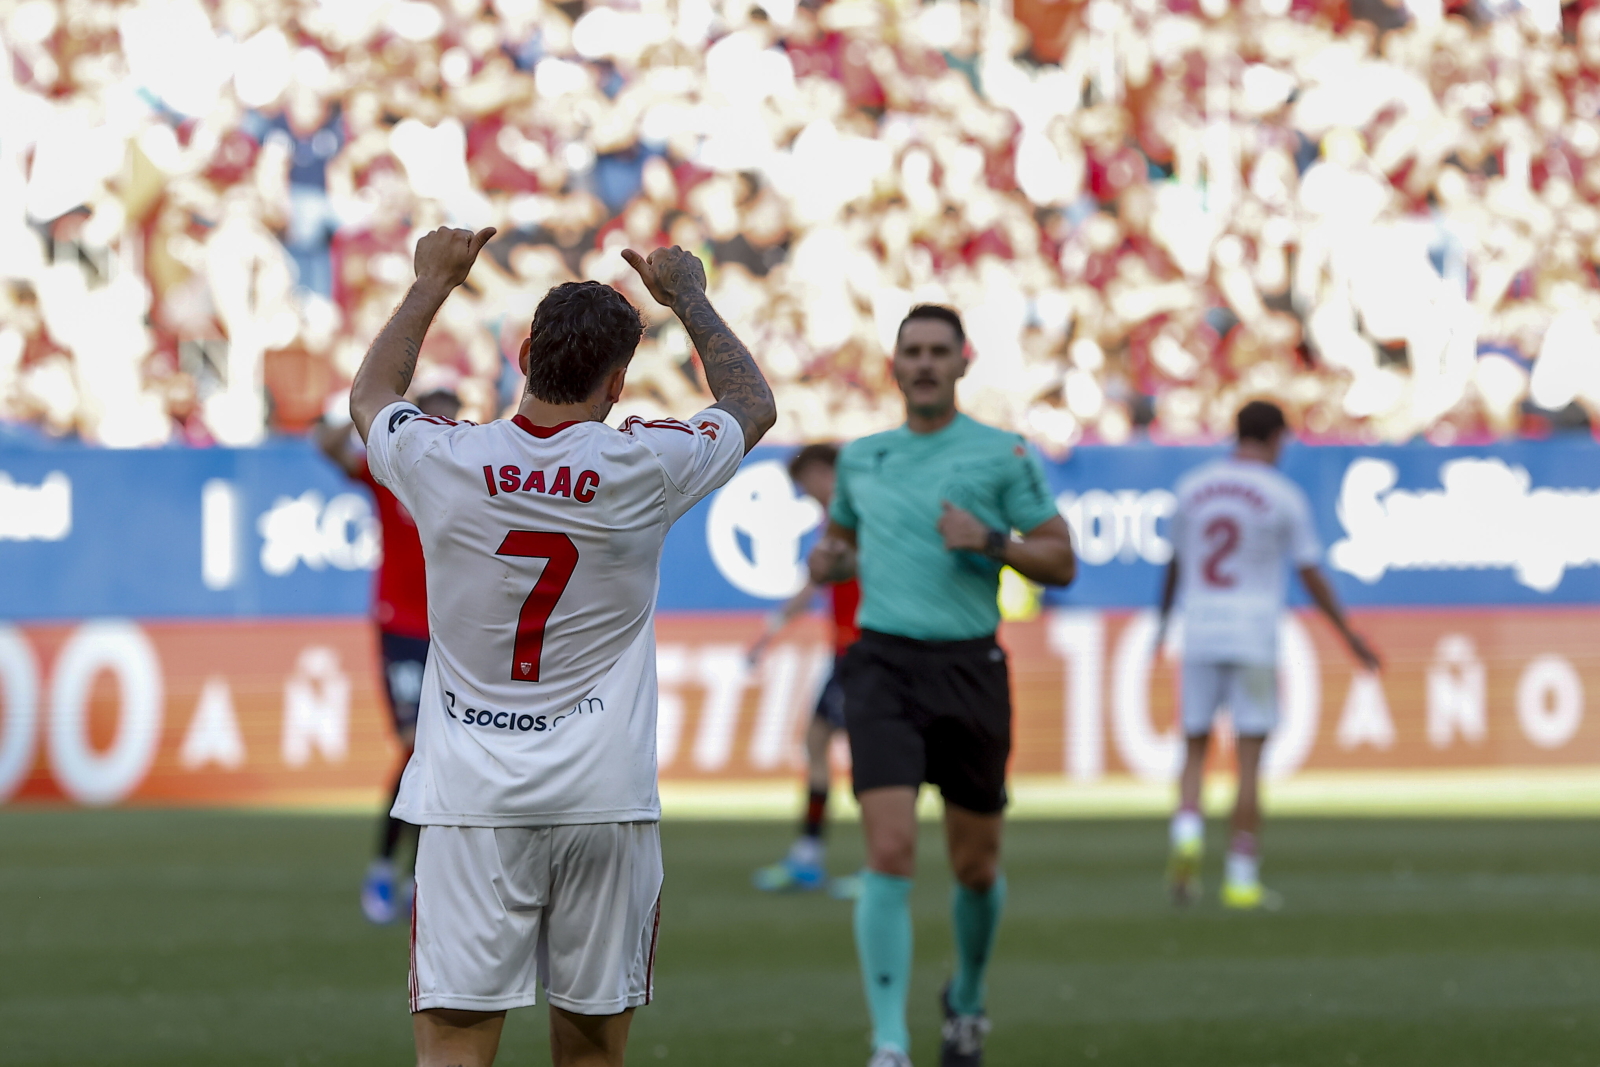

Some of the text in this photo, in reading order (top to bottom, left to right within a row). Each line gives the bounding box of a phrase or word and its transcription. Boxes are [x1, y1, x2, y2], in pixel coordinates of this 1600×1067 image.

[482, 464, 601, 504] ISAAC
[1202, 514, 1242, 589] 2
[494, 529, 580, 683] 7
